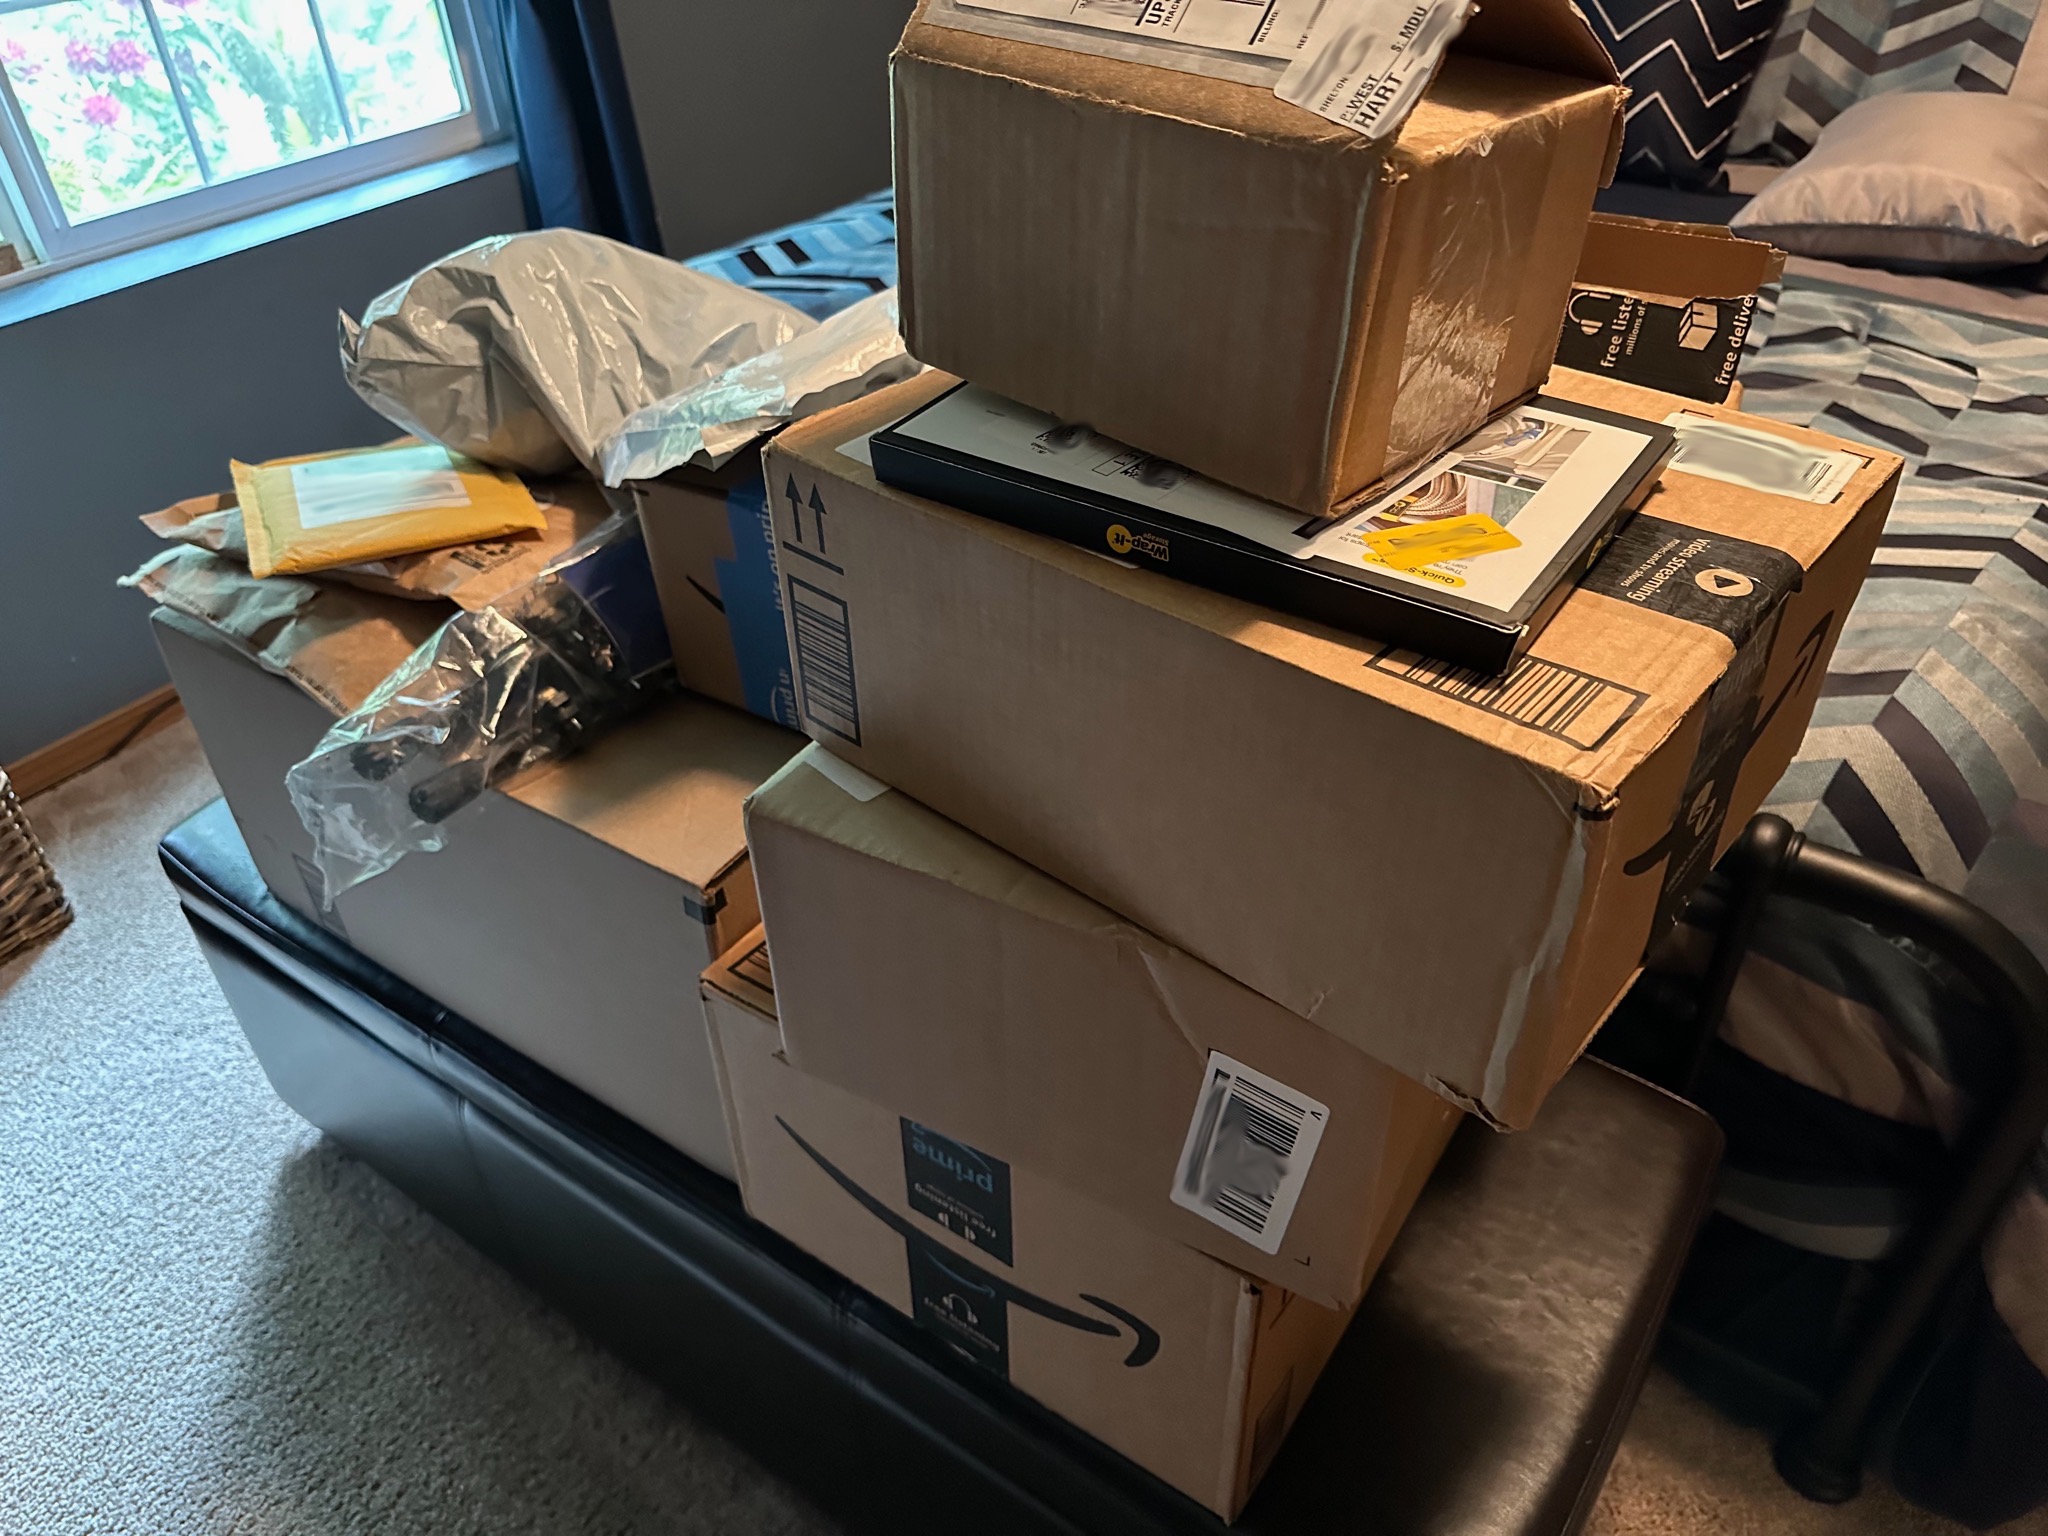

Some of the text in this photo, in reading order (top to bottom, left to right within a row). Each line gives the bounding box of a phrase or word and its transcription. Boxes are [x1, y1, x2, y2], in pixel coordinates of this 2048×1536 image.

[1145, 0, 1170, 24] UP
[1257, 9, 1281, 43] BILLING:
[1399, 6, 1427, 40] MDU
[1296, 33, 1308, 50] REF
[1354, 72, 1403, 128] HART
[1625, 317, 1644, 356] millions
[1637, 305, 1647, 317] of
[1600, 335, 1623, 368] free
[1715, 351, 1737, 386] free
[1111, 532, 1170, 562] Wrap-It
[1646, 553, 1663, 566] and
[1620, 569, 1644, 587] shows
[1626, 538, 1711, 602] video streaming
[1640, 563, 1652, 571] tv
[912, 1136, 993, 1193] prime
[971, 1217, 997, 1239] free
